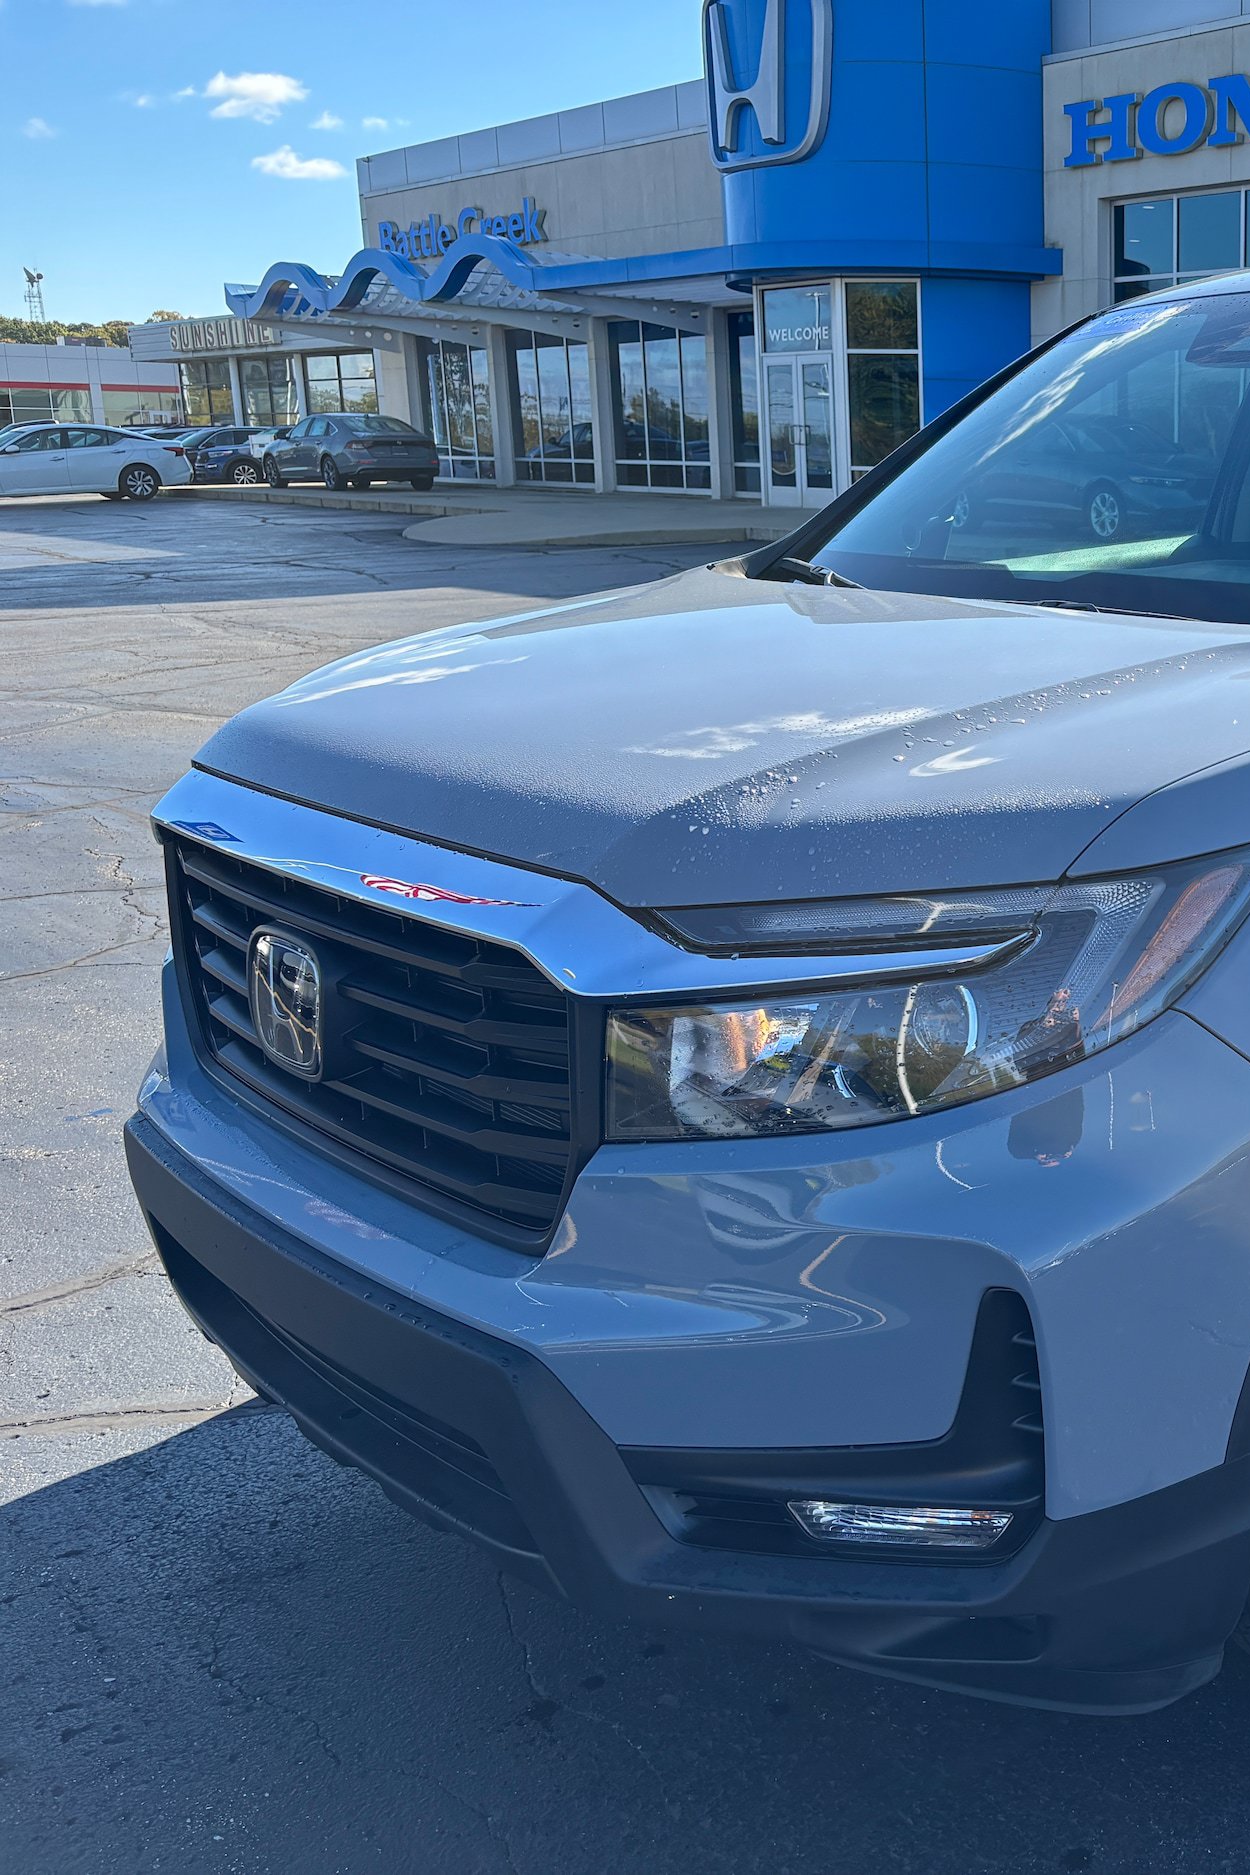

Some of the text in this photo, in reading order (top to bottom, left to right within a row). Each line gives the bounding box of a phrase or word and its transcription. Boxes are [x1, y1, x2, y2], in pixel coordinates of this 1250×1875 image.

[378, 196, 546, 258] Battle Creek
[169, 319, 272, 350] SUNSHINE
[769, 326, 829, 342] WELCOME
